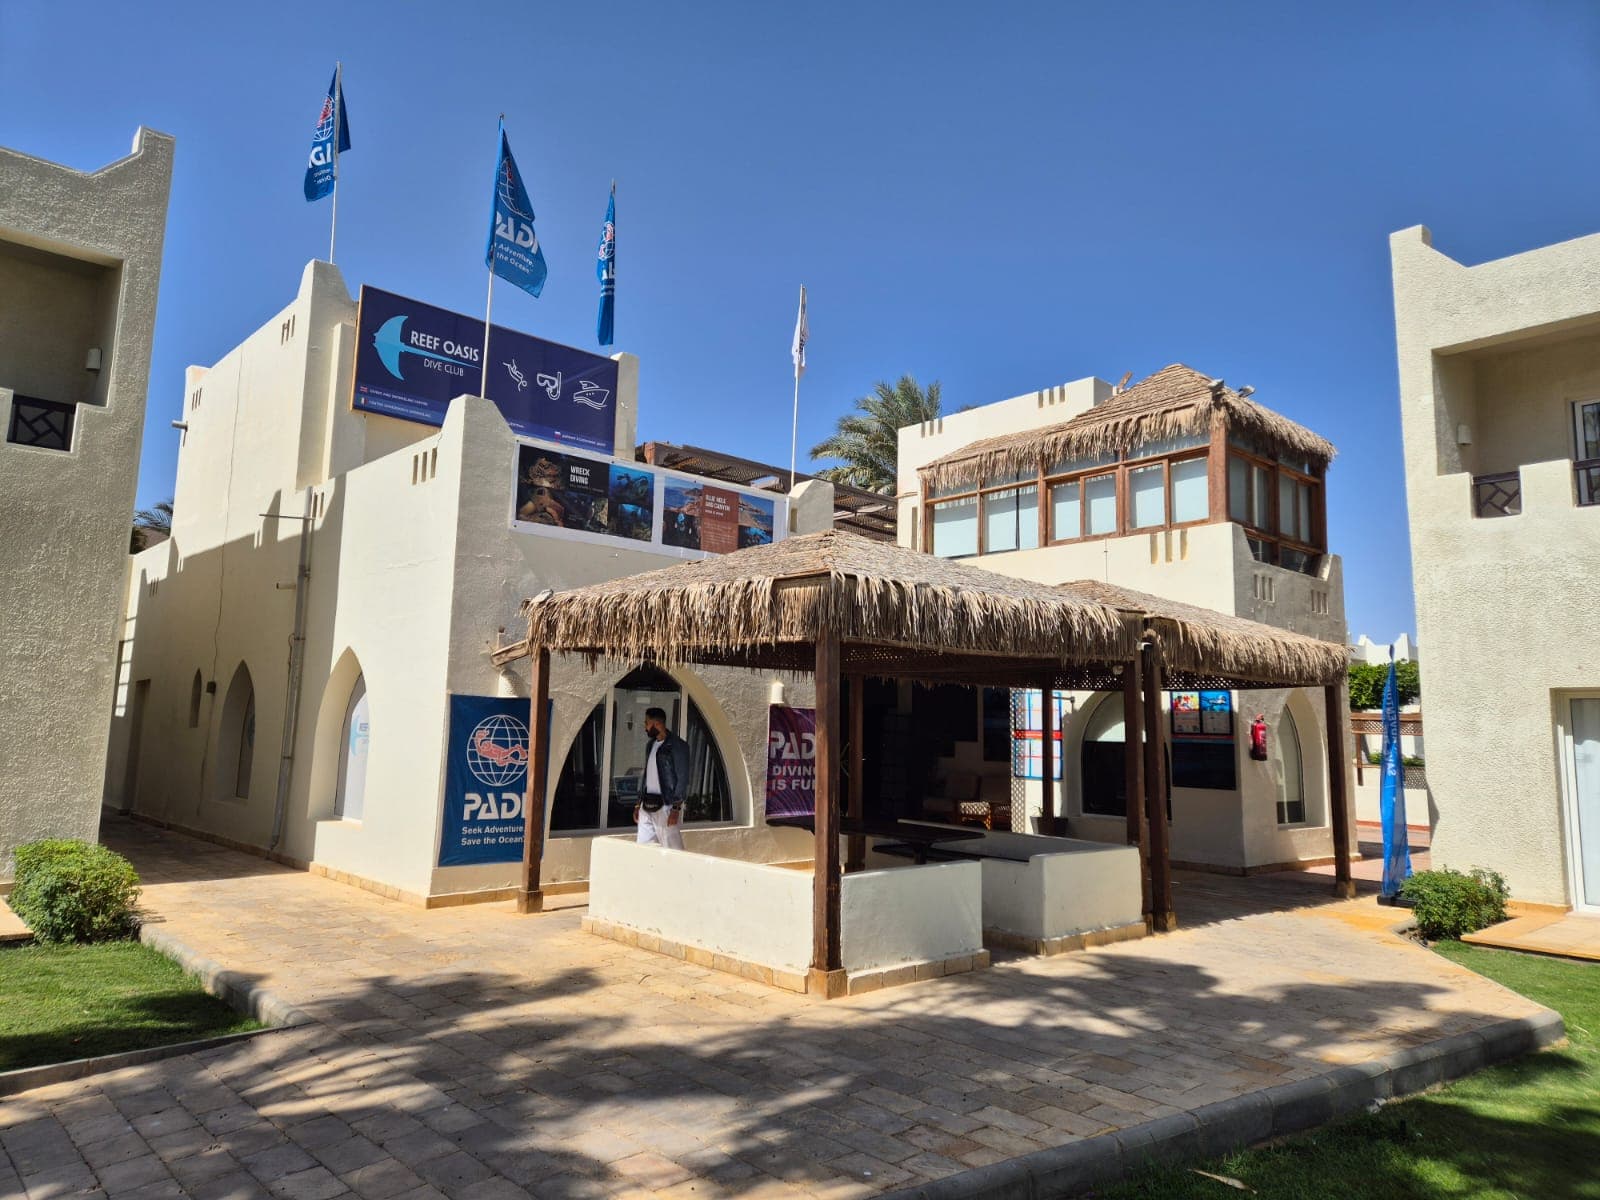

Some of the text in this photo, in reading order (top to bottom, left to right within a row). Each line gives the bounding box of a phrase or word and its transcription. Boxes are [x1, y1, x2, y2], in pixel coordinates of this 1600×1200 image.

[411, 331, 479, 361] REEF OASIS
[424, 359, 464, 376] DIVE CLUB
[571, 465, 590, 477] WRECK
[570, 474, 589, 485] DIVING
[770, 731, 816, 760] PAD
[771, 779, 786, 791] IS
[462, 826, 482, 835] Seek
[461, 836, 524, 846] Save the Ocean
